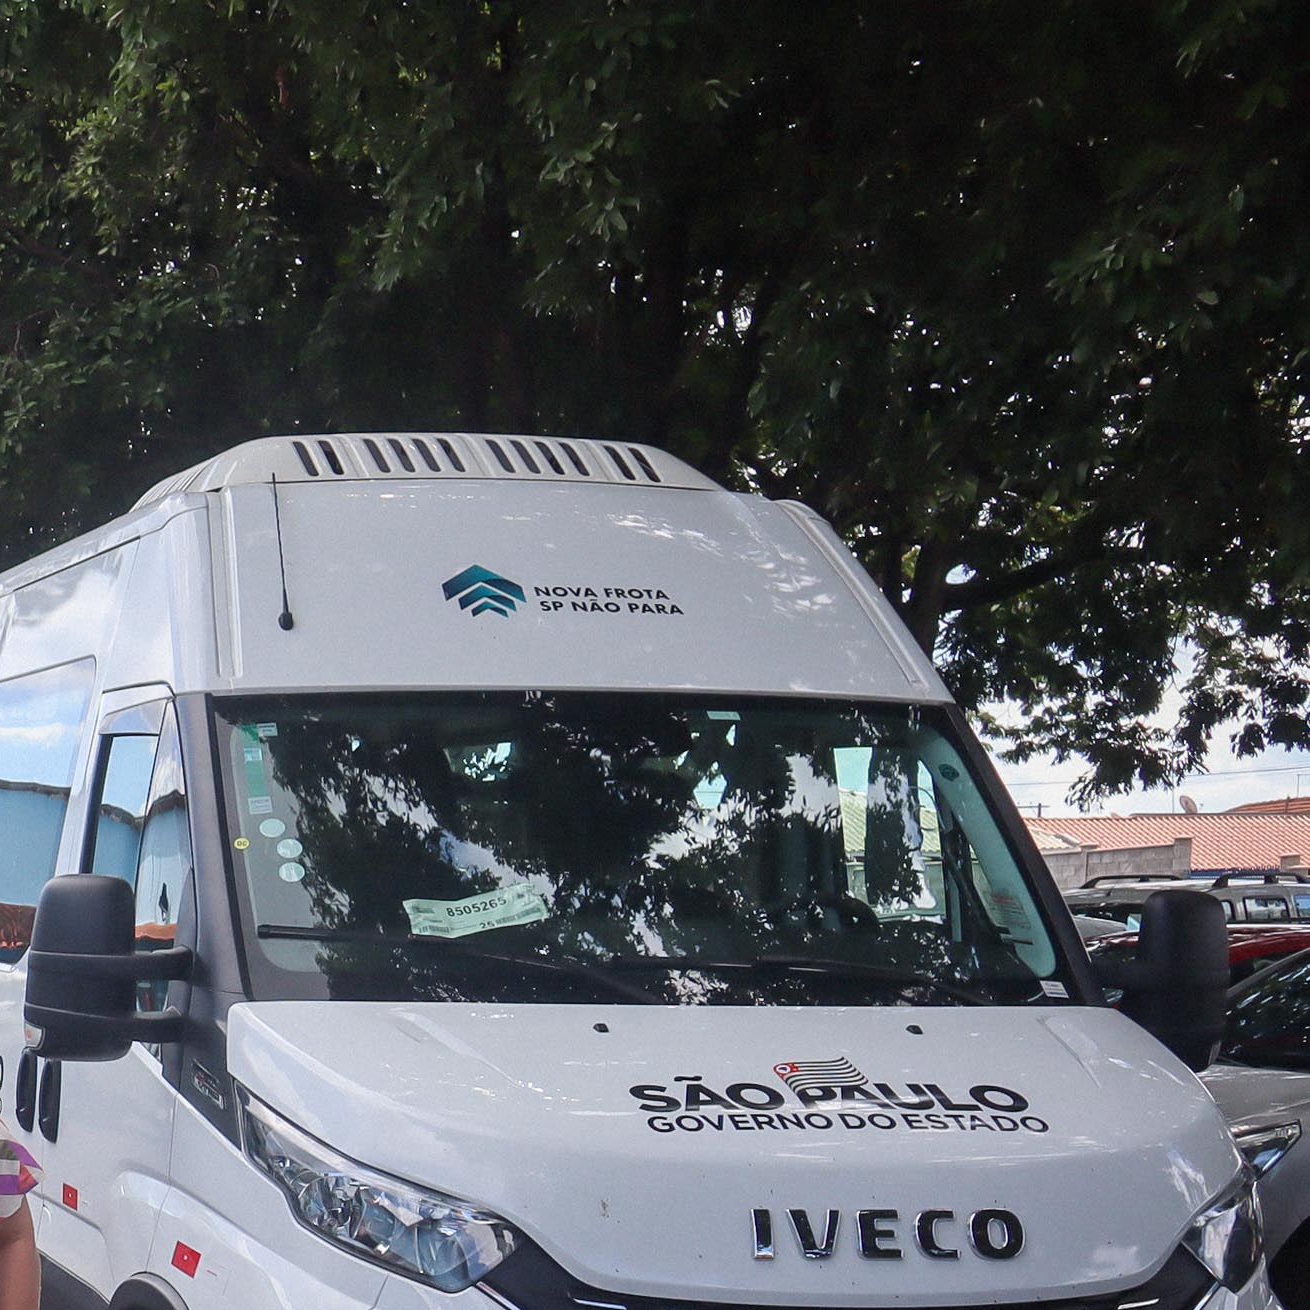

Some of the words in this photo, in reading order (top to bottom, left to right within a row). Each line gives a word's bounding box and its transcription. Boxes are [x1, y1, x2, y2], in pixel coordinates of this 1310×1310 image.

[533, 586, 598, 598] NOVA
[603, 587, 670, 601] FROTA
[539, 600, 564, 612] SP
[570, 598, 621, 613] NÃO
[627, 602, 685, 616] PARA
[445, 896, 508, 918] 8505265
[629, 1075, 786, 1112] SÃO
[794, 1082, 1030, 1114] PAULO
[646, 1112, 835, 1134] GOVERNO
[841, 1112, 898, 1131] DO
[904, 1113, 1051, 1134] ESTADO
[750, 1208, 1028, 1261] IVECO
